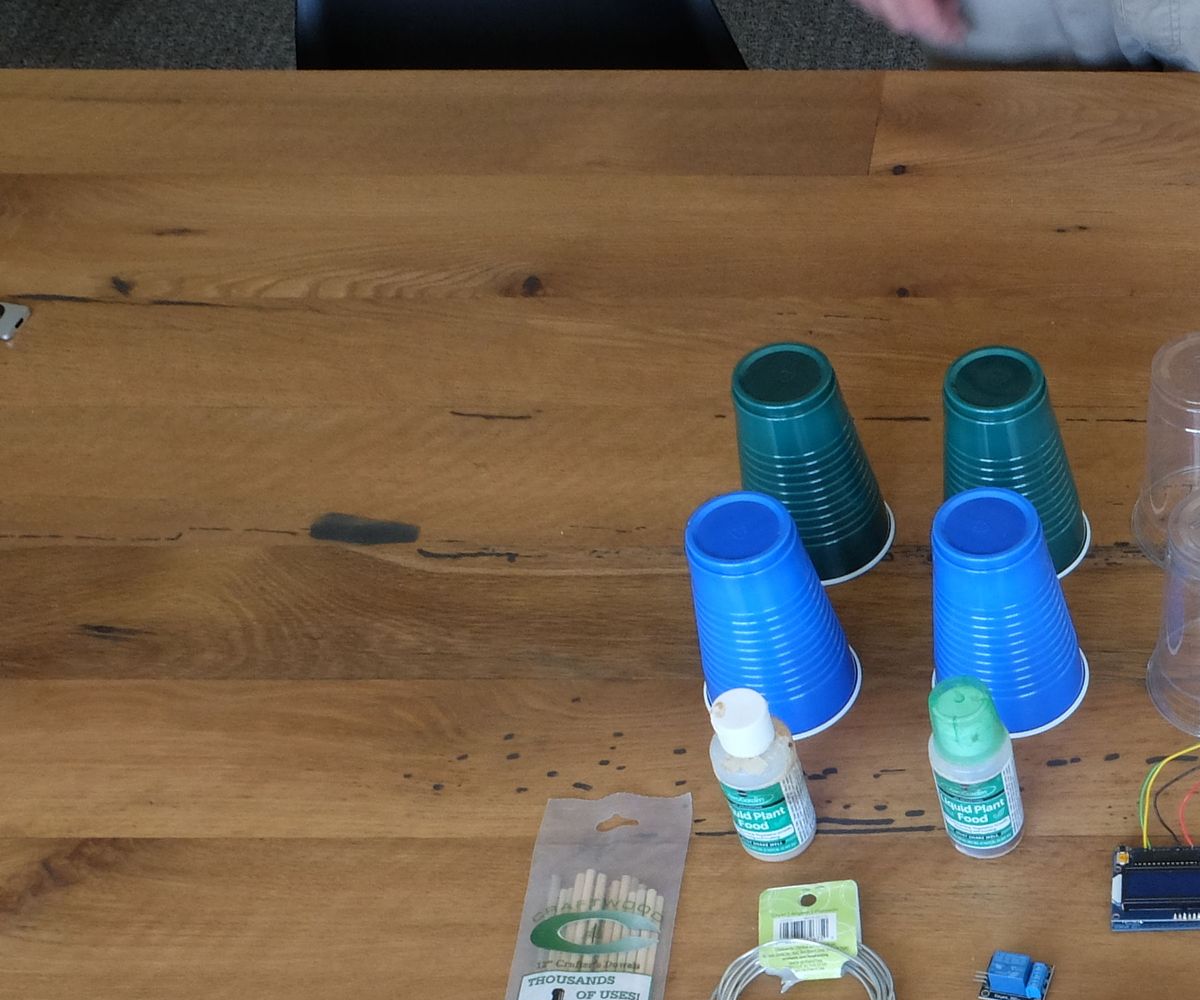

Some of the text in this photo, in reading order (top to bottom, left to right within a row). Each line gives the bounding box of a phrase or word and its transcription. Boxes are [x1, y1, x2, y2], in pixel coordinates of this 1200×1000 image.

[974, 799, 1006, 814] Plant
[752, 806, 786, 821] Plant
[957, 813, 989, 824] Food
[737, 819, 770, 831] Food
[528, 974, 616, 987] THOUSANDS
[576, 991, 597, 1000] OF
